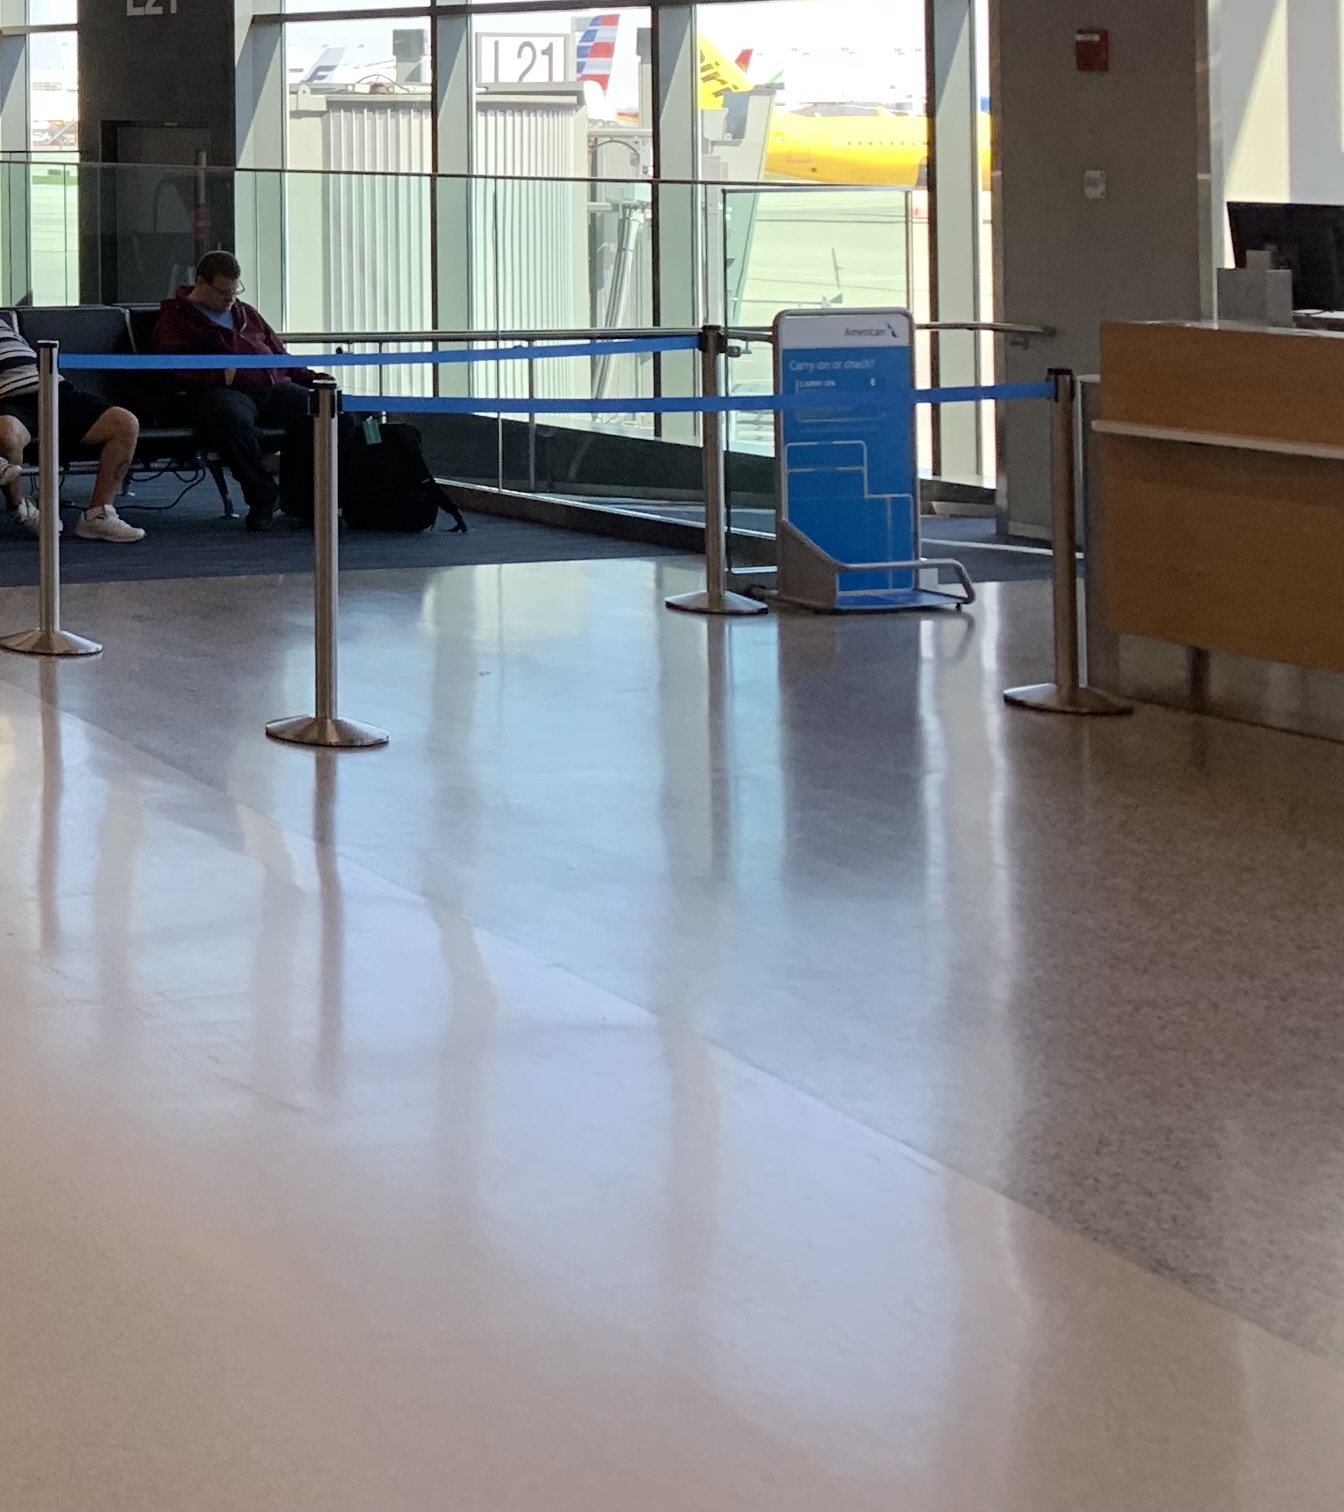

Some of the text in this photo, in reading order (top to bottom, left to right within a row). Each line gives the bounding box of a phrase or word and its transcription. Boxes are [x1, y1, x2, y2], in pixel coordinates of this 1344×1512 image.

[844, 327, 886, 337] American
[789, 359, 831, 373] Carry-on
[832, 361, 843, 370] or
